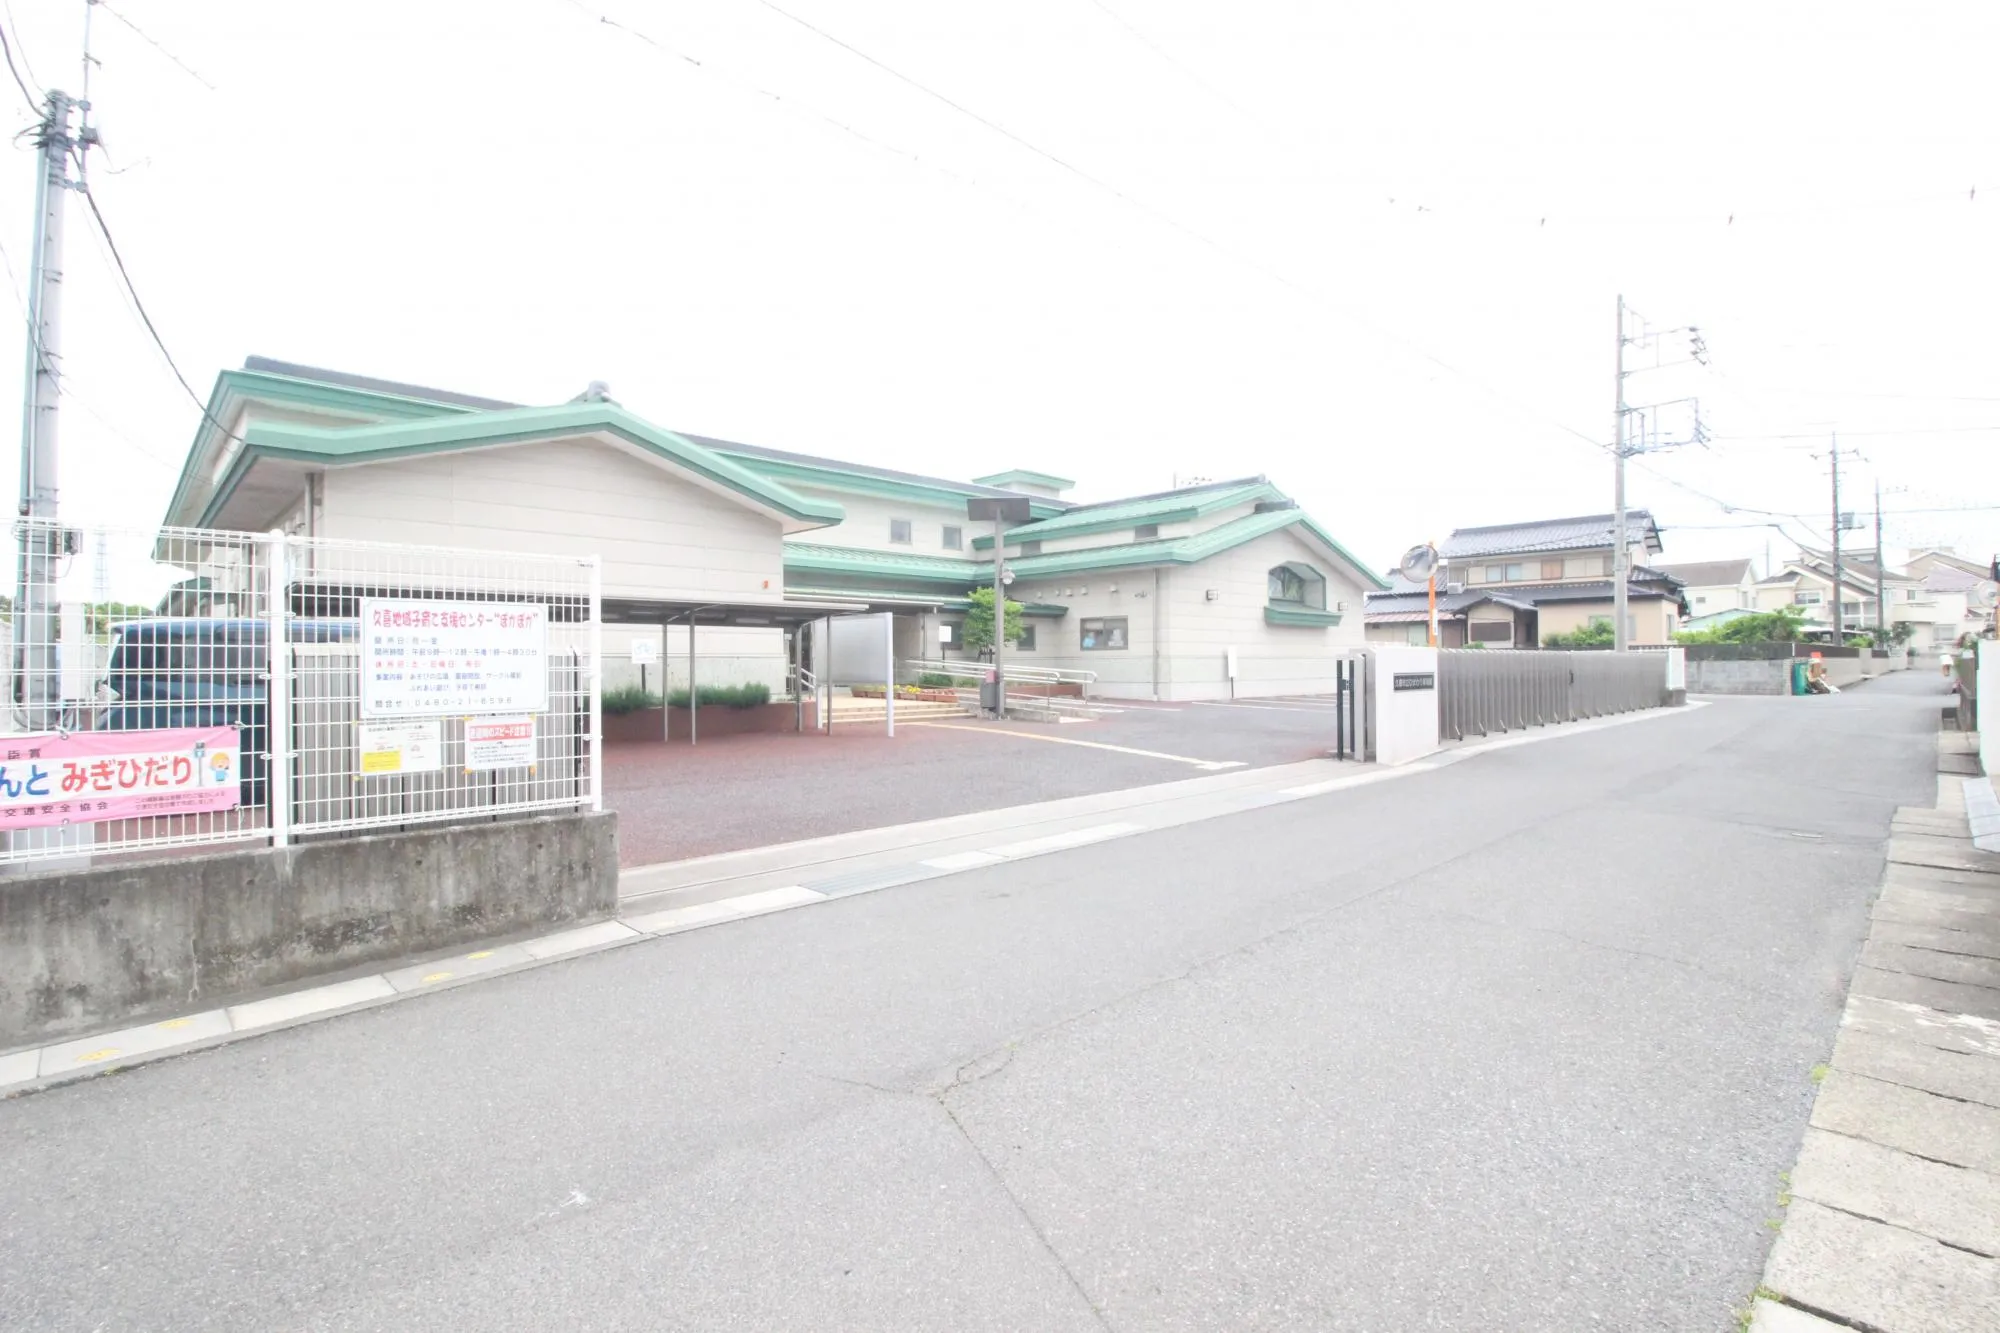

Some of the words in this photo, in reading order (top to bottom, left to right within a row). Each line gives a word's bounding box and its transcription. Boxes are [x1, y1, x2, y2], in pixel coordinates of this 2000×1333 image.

[61, 755, 191, 793] みぎひだり
